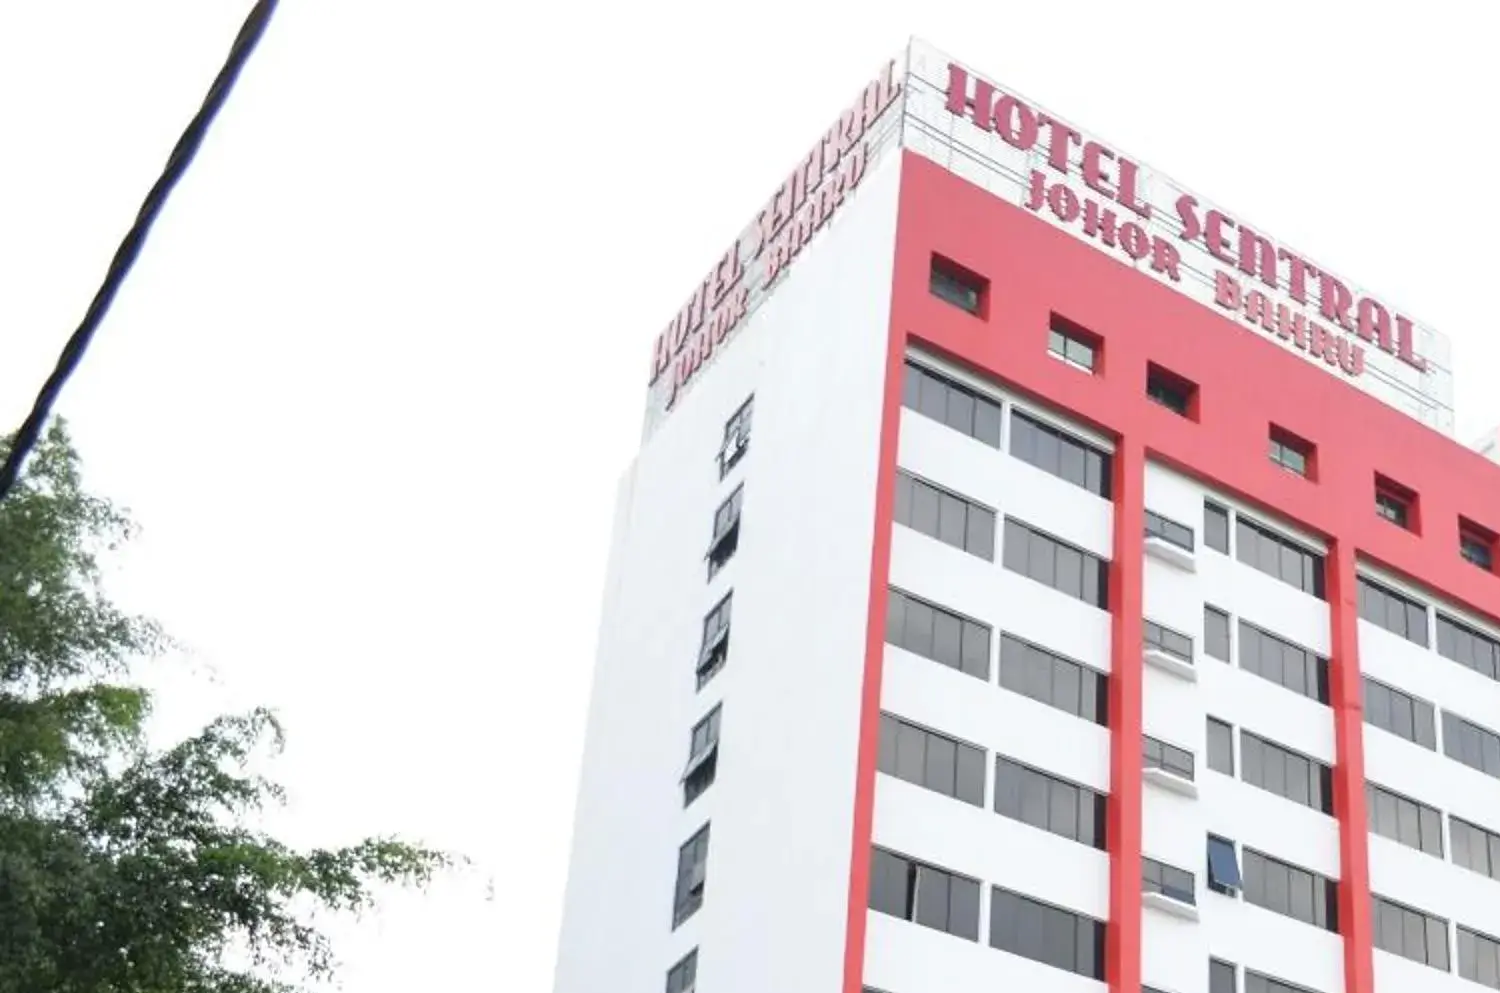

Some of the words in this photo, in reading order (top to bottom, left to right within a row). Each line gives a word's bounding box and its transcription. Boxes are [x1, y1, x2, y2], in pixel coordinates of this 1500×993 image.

[945, 62, 1151, 220] HOTEL
[1175, 194, 1429, 374] SENTRAL
[1023, 169, 1181, 282] JOHOR
[1214, 269, 1365, 377] BAHRU
